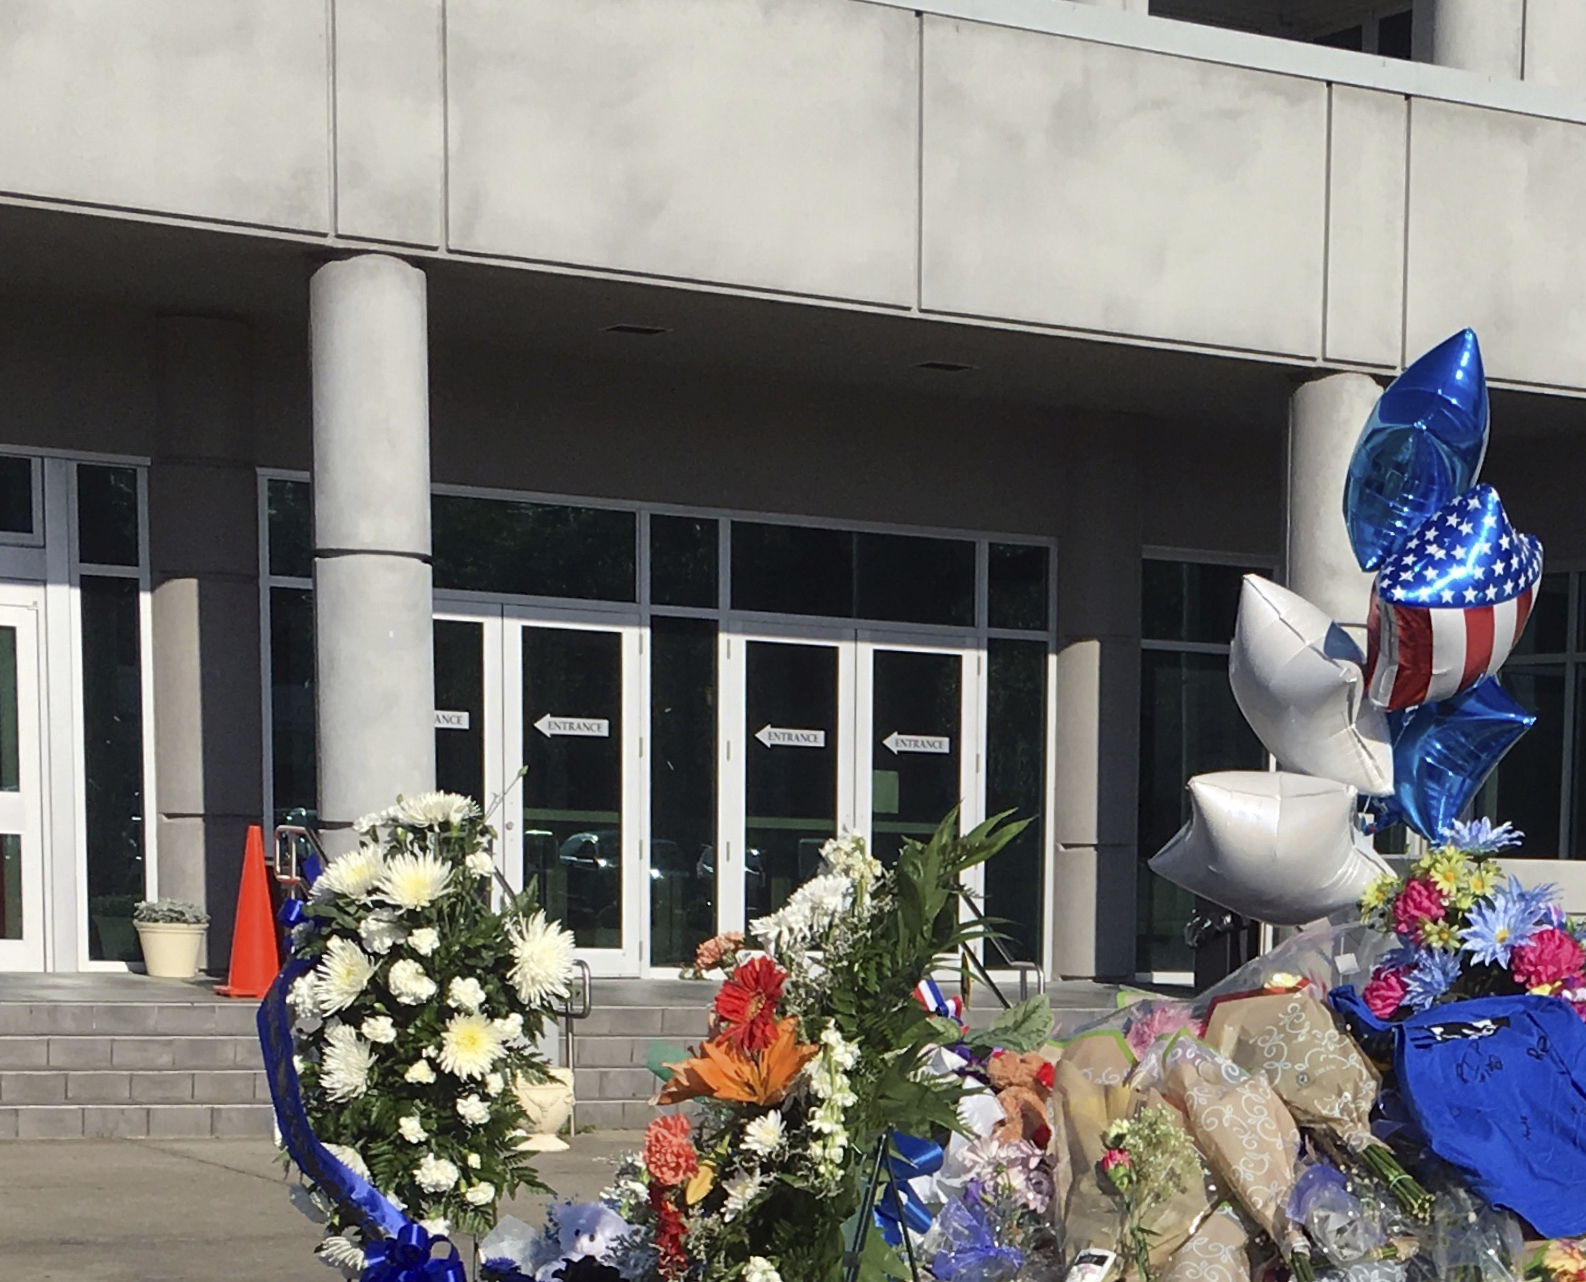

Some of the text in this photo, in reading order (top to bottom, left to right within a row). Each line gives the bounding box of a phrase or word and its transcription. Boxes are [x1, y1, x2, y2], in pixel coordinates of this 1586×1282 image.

[434, 714, 463, 725] ANCE
[547, 720, 603, 732] ENTRANCE
[768, 731, 819, 743] ENTRANCE
[894, 738, 944, 750] ENTRANCE
